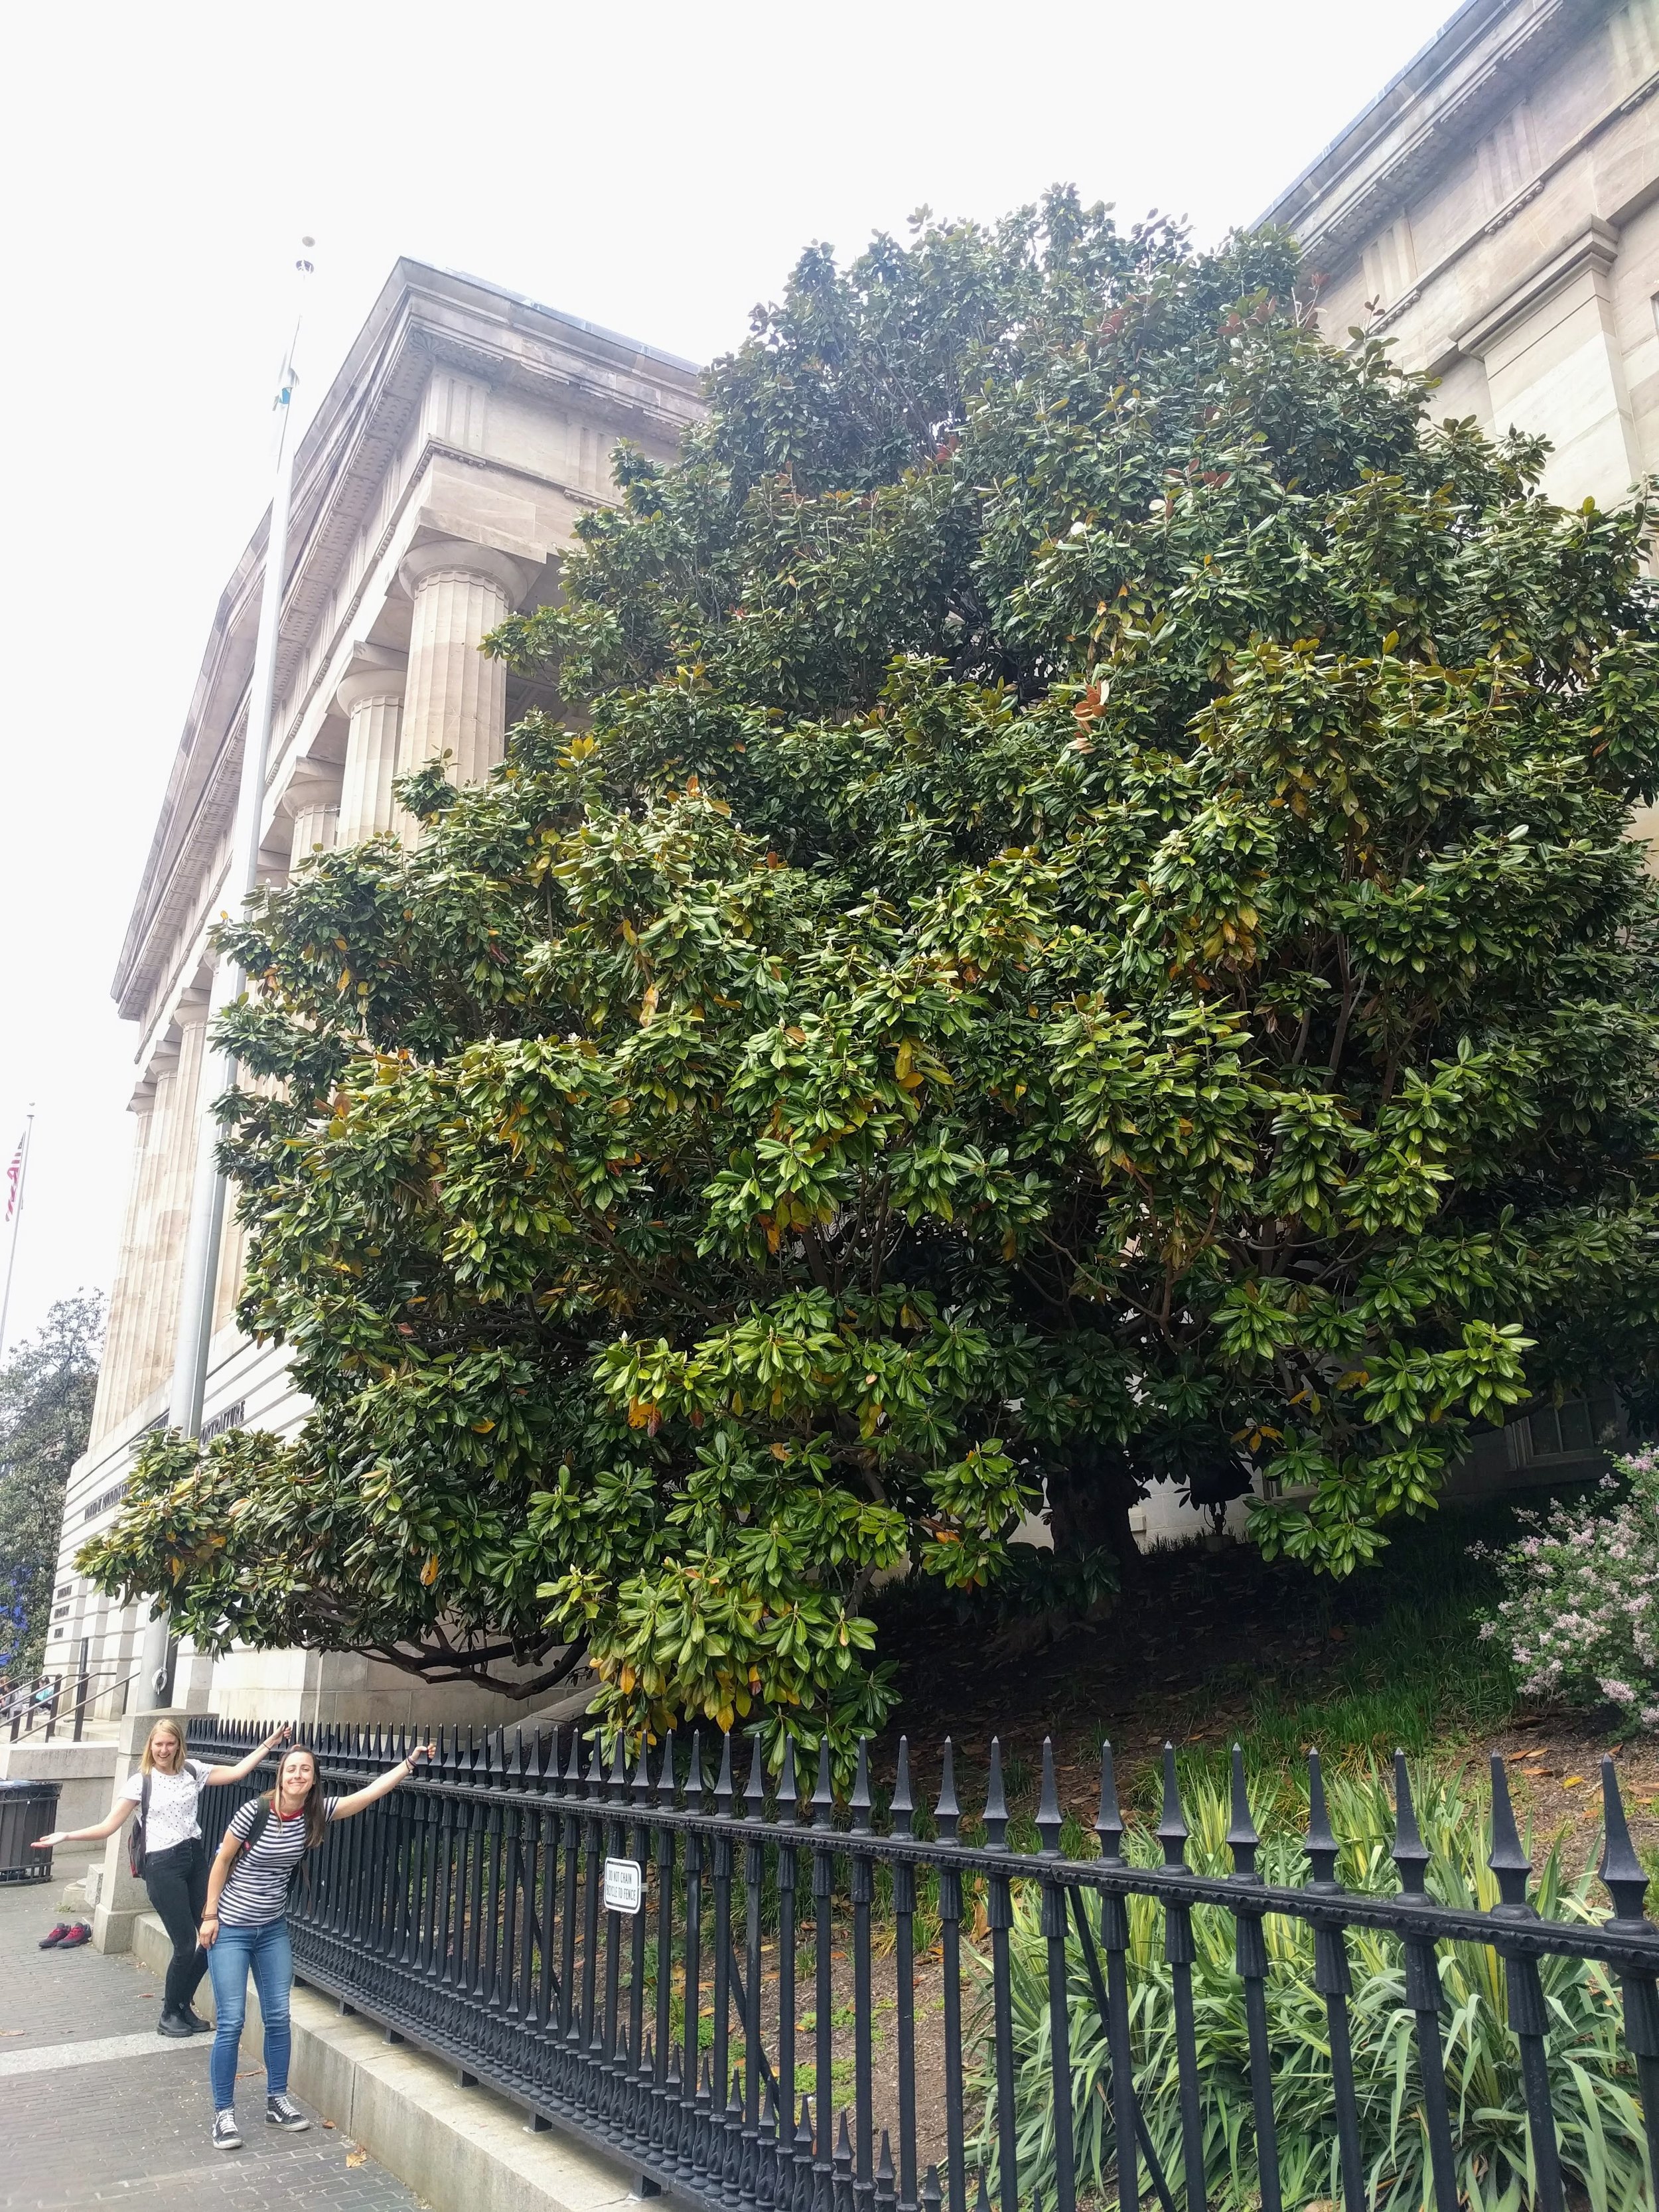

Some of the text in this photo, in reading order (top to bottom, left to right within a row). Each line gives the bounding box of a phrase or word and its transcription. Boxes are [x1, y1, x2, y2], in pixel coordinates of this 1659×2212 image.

[609, 1870, 613, 1881] DO
[620, 1872, 632, 1885] CHAIN
[618, 1887, 622, 1899] TO
[623, 1888, 636, 1901] FENCE
